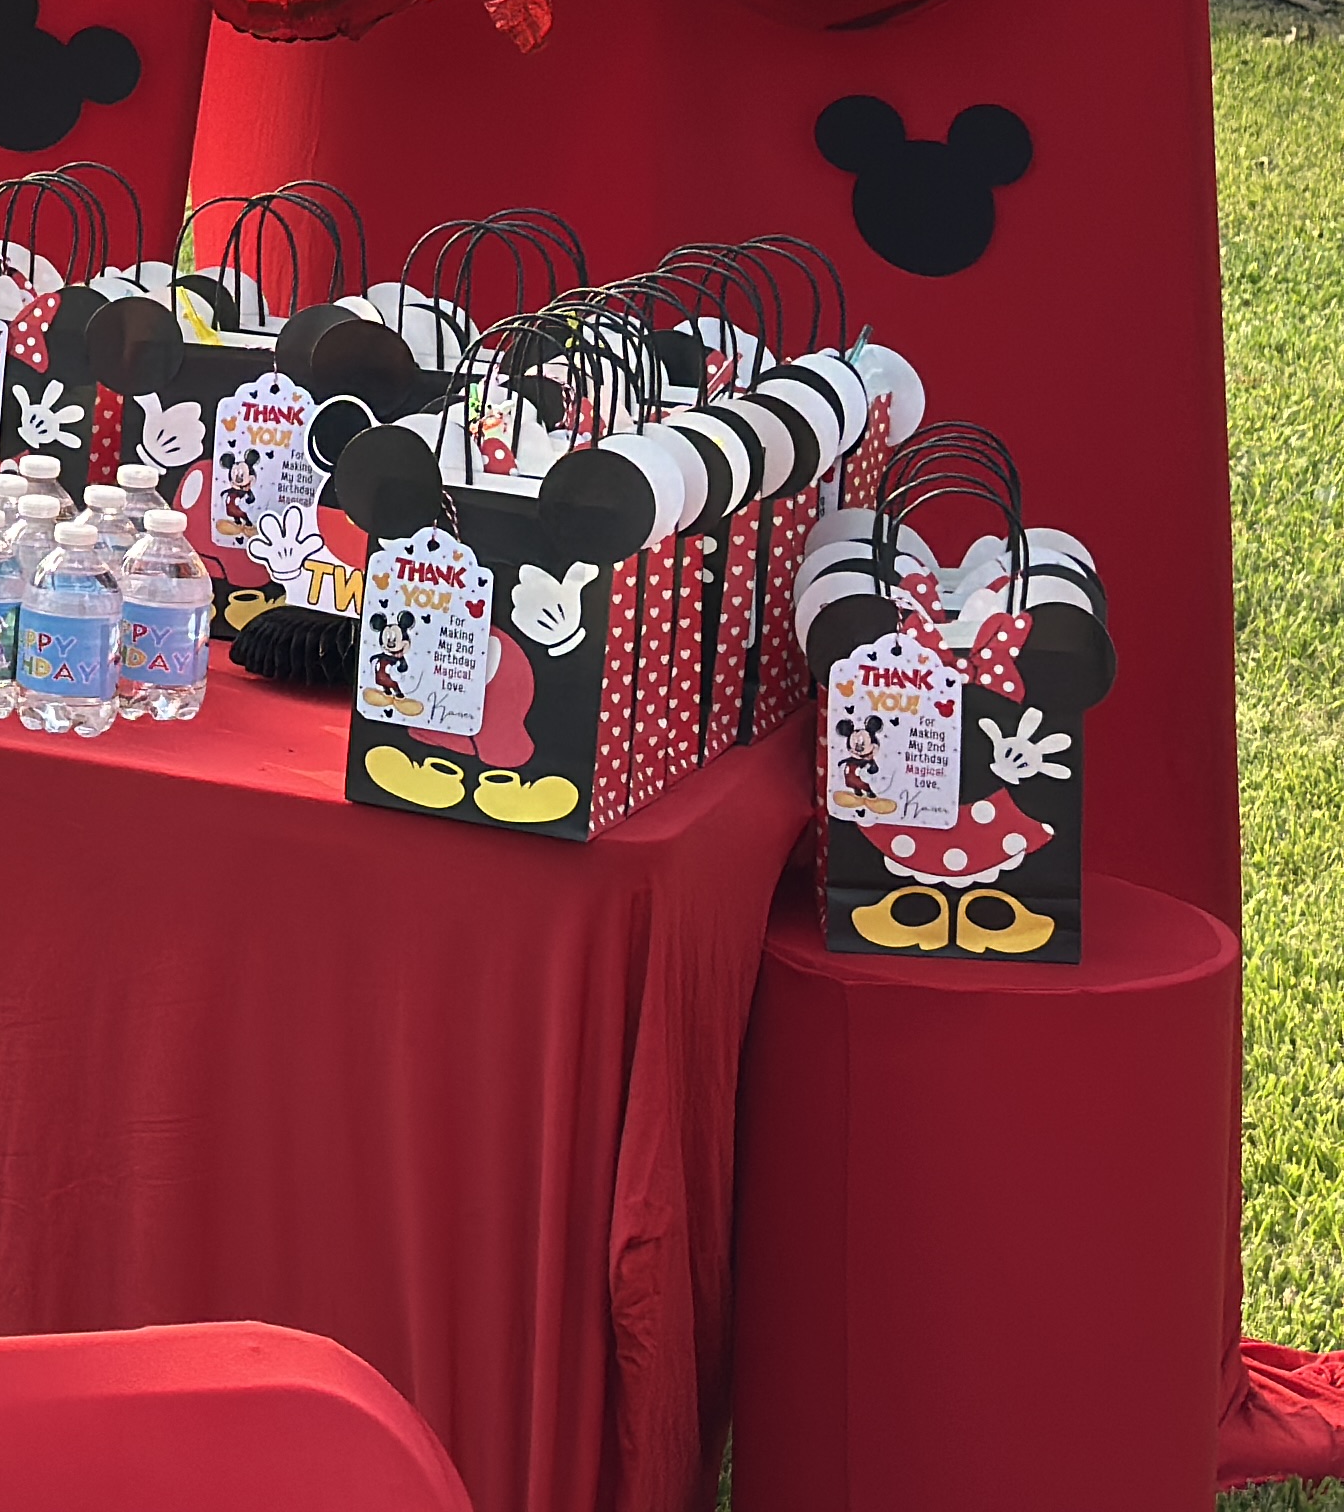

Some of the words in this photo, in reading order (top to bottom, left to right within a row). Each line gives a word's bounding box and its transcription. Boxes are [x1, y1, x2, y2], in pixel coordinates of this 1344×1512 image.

[242, 401, 305, 426] THANK
[247, 425, 292, 448] YOU!
[282, 461, 312, 474] Making
[281, 472, 293, 483] My
[297, 473, 312, 484] 2nd
[278, 483, 315, 497] Birthday
[395, 557, 467, 588] THANK
[302, 558, 364, 616] TW
[401, 583, 452, 613] YOU!
[440, 627, 474, 643] Making
[438, 639, 452, 653] My
[456, 643, 474, 654] 2nd
[434, 651, 475, 670] Birthday
[859, 665, 934, 691] THANK
[867, 690, 920, 715] YOU!
[910, 728, 945, 742] Making
[908, 740, 924, 752] My
[927, 741, 946, 752] 2nd
[905, 752, 948, 766] Birthday
